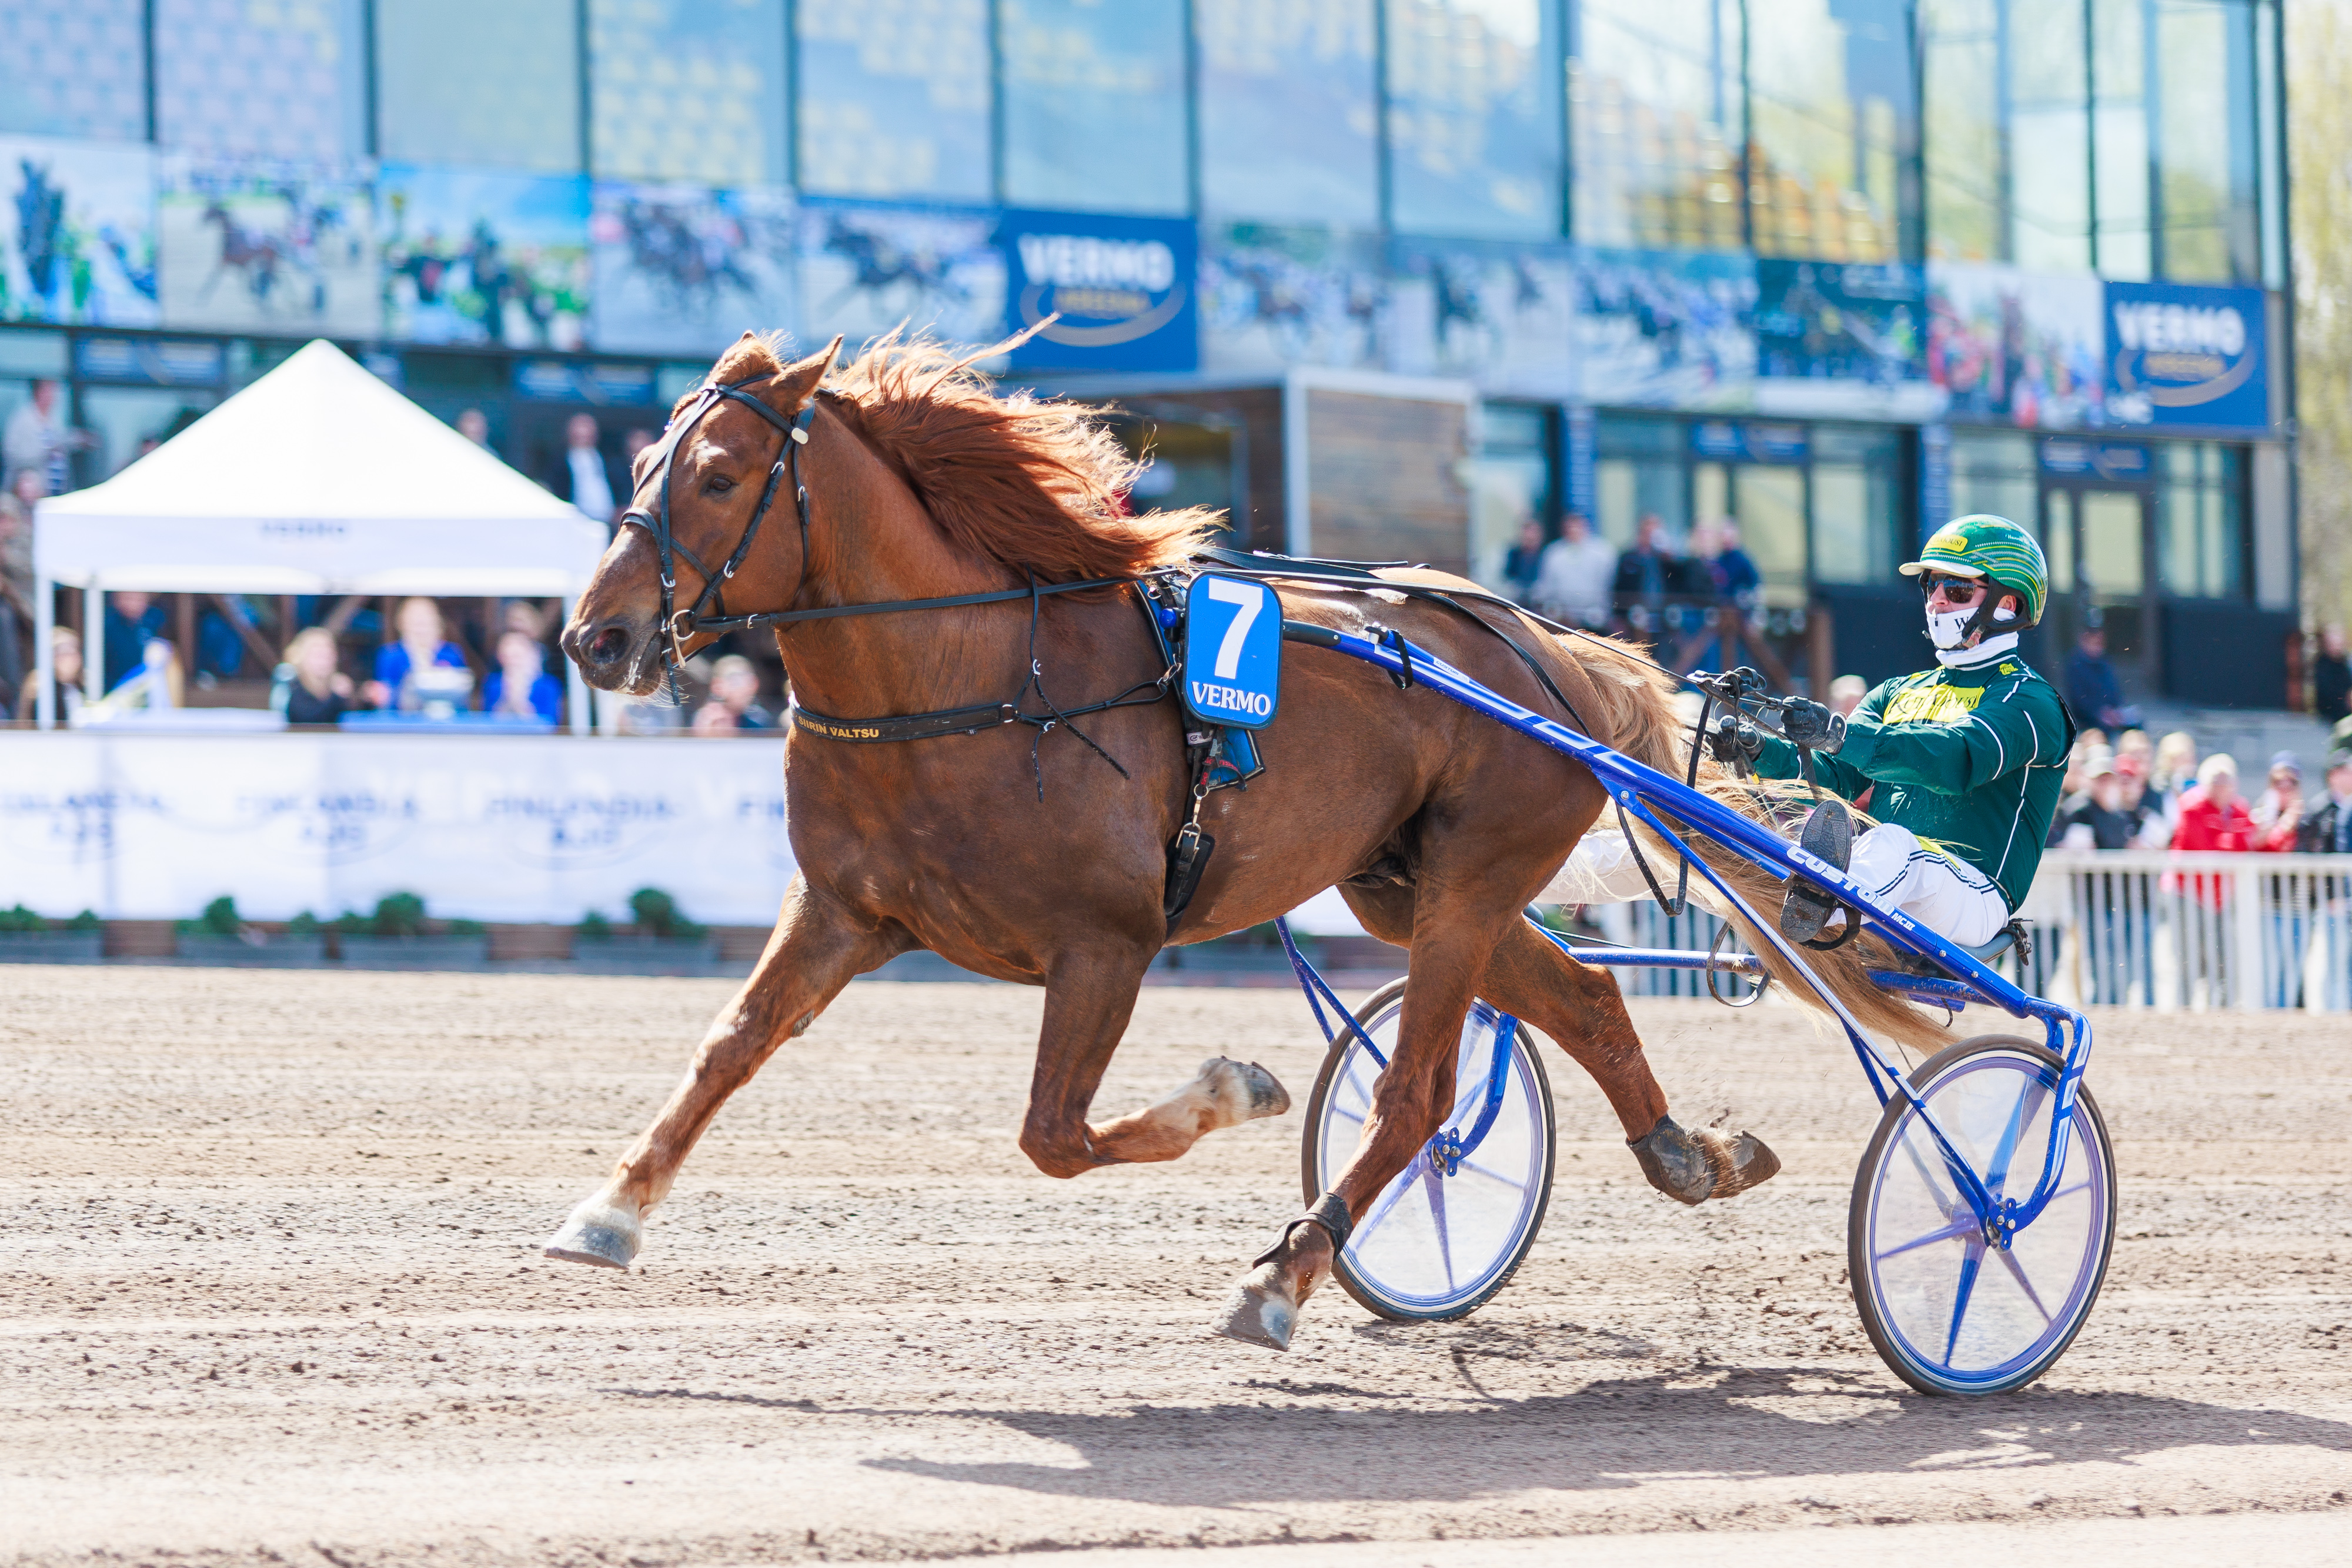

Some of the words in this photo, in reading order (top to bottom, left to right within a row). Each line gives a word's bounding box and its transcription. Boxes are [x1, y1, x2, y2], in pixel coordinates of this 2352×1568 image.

[1018, 233, 1175, 293] VERMO
[2114, 302, 2246, 356] VERMO
[1208, 578, 1263, 680] 7
[1436, 660, 1459, 676] CUSTOM
[1191, 681, 1271, 716] VERMO
[798, 716, 827, 734] SIIRIN
[829, 727, 880, 738] VALTSU
[1786, 845, 1895, 917] CUSTOM
